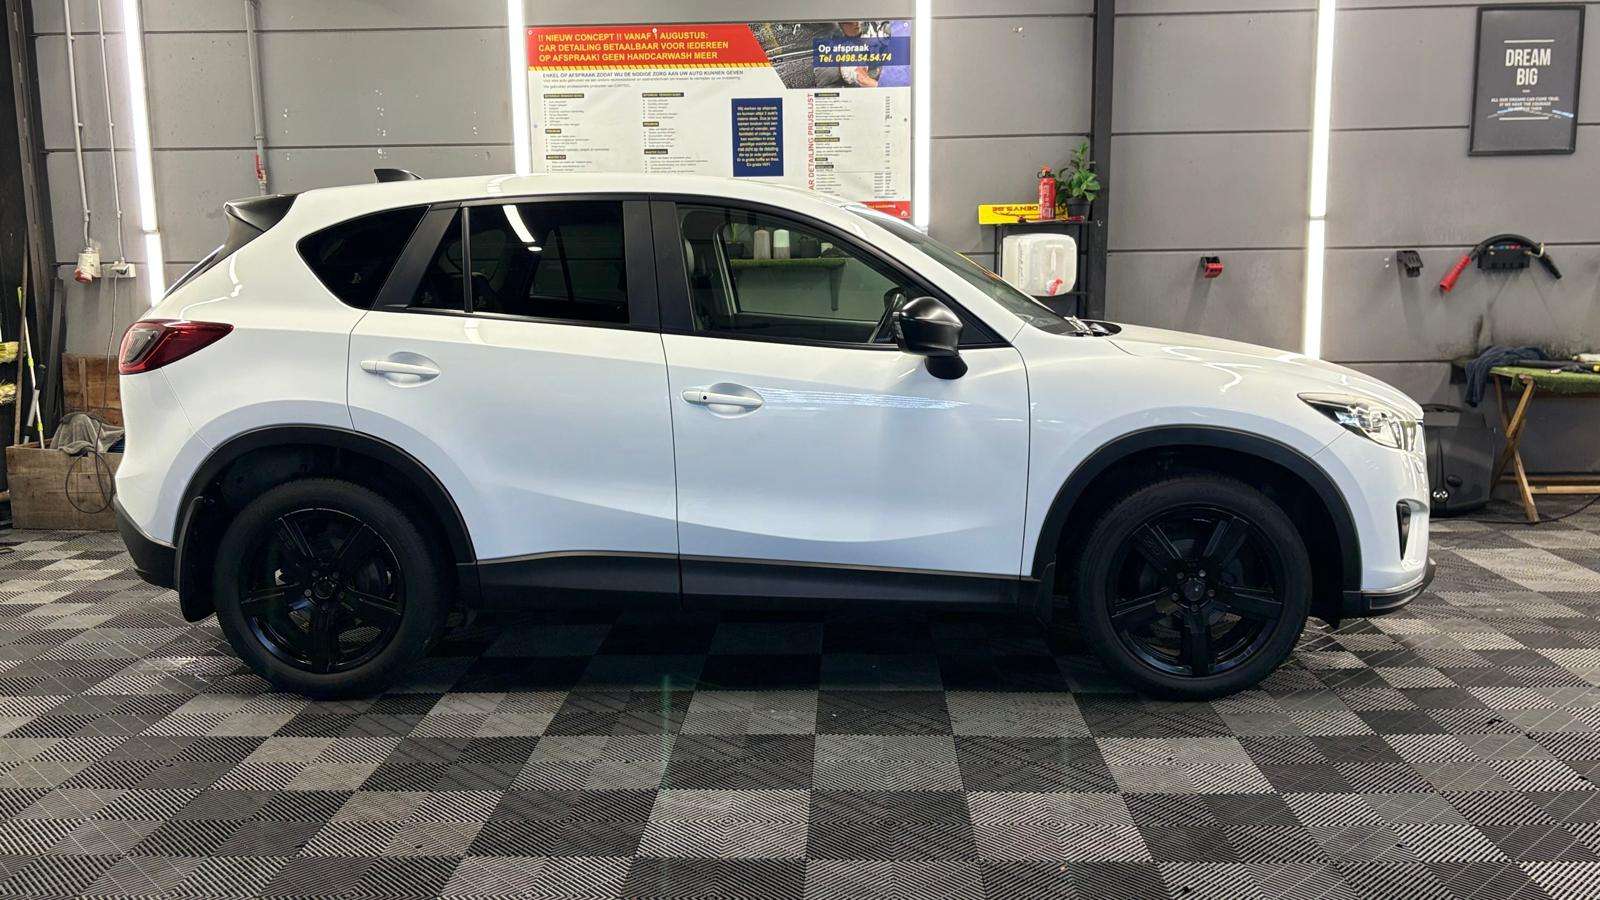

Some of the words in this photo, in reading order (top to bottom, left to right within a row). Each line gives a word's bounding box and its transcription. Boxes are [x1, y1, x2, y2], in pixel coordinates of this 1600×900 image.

[537, 34, 543, 42] !!
[545, 34, 573, 42] NIEUW
[574, 33, 614, 41] CONCEPT
[616, 33, 622, 41] !!
[624, 32, 651, 40] VANAF
[660, 31, 709, 39] AUGUSTUS:
[538, 44, 556, 52] CAR
[558, 43, 601, 51] DETAILING
[603, 42, 659, 50] BETAALBAAR
[661, 42, 685, 50] VOOR
[687, 41, 729, 49] IEDEREEN
[818, 45, 831, 54] Op
[833, 44, 869, 53] afspraak
[538, 54, 551, 62] OP
[552, 54, 600, 62] AFSPRAAK!
[602, 53, 625, 61] GEEN
[626, 52, 692, 60] HANDCARWASH
[694, 51, 718, 59] MEER
[819, 54, 833, 63] Tel.
[835, 53, 892, 62] 0498.54.54.74
[1505, 48, 1551, 66] DREAM
[1516, 67, 1538, 86] BIG
